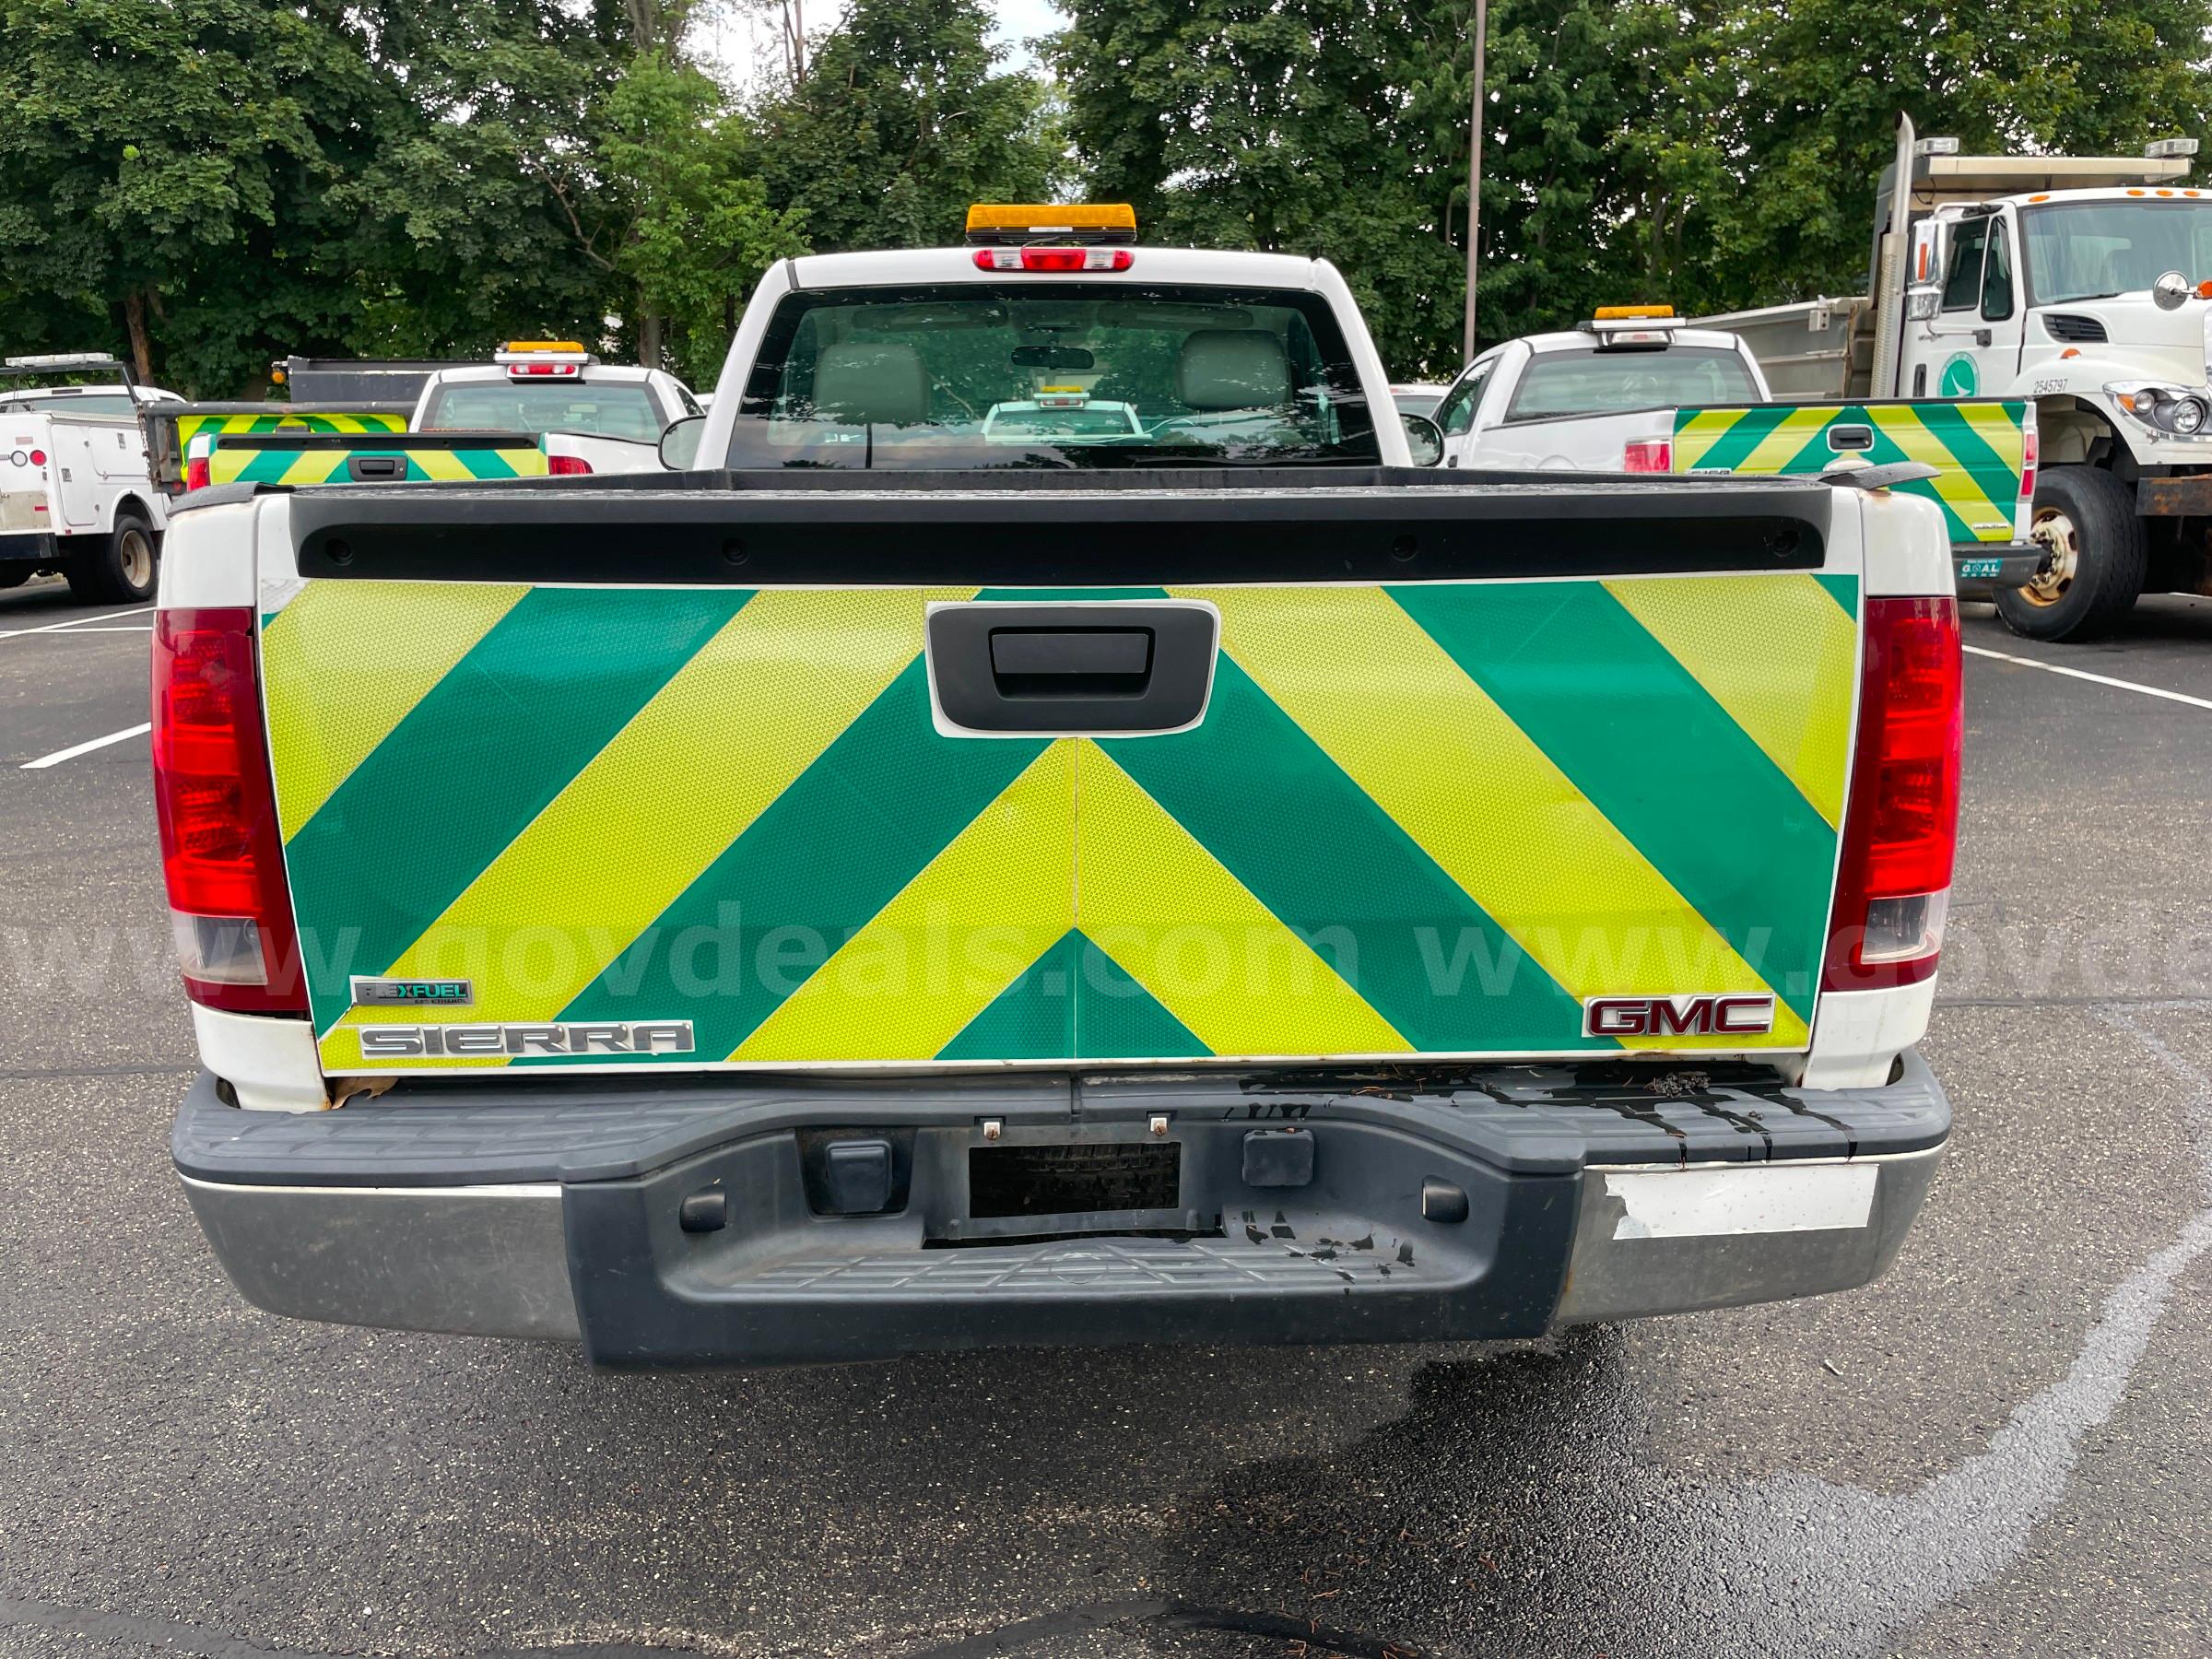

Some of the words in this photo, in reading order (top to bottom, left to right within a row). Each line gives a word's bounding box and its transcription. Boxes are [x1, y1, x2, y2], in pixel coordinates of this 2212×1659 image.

[2034, 378, 2068, 393] 2545797
[1588, 994, 1773, 1036] GMC
[361, 1022, 694, 1056] SIERRA
